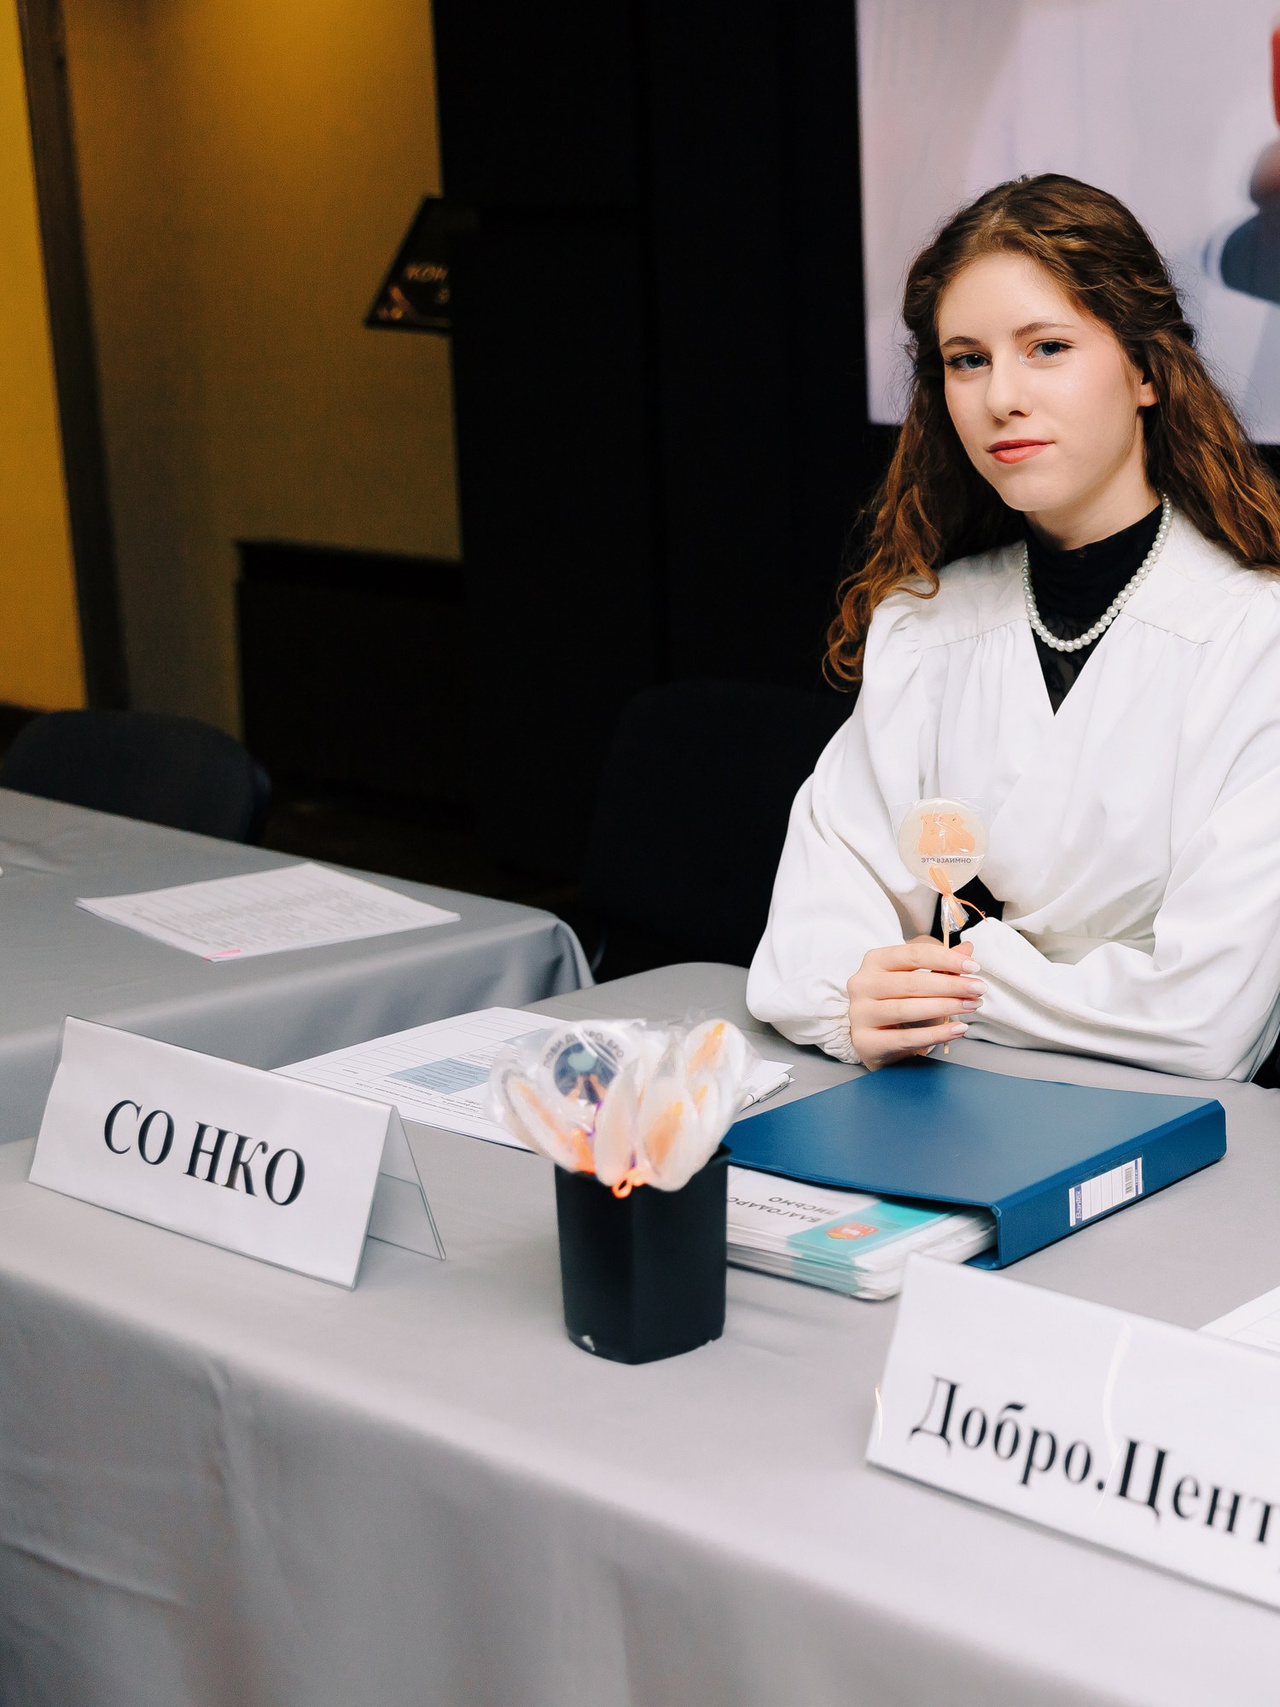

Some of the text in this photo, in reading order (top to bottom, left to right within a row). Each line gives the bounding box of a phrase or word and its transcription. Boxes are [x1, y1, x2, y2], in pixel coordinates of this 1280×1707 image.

[103, 1099, 306, 1207] СО НКО
[768, 1196, 840, 1216] ПИСЬМО
